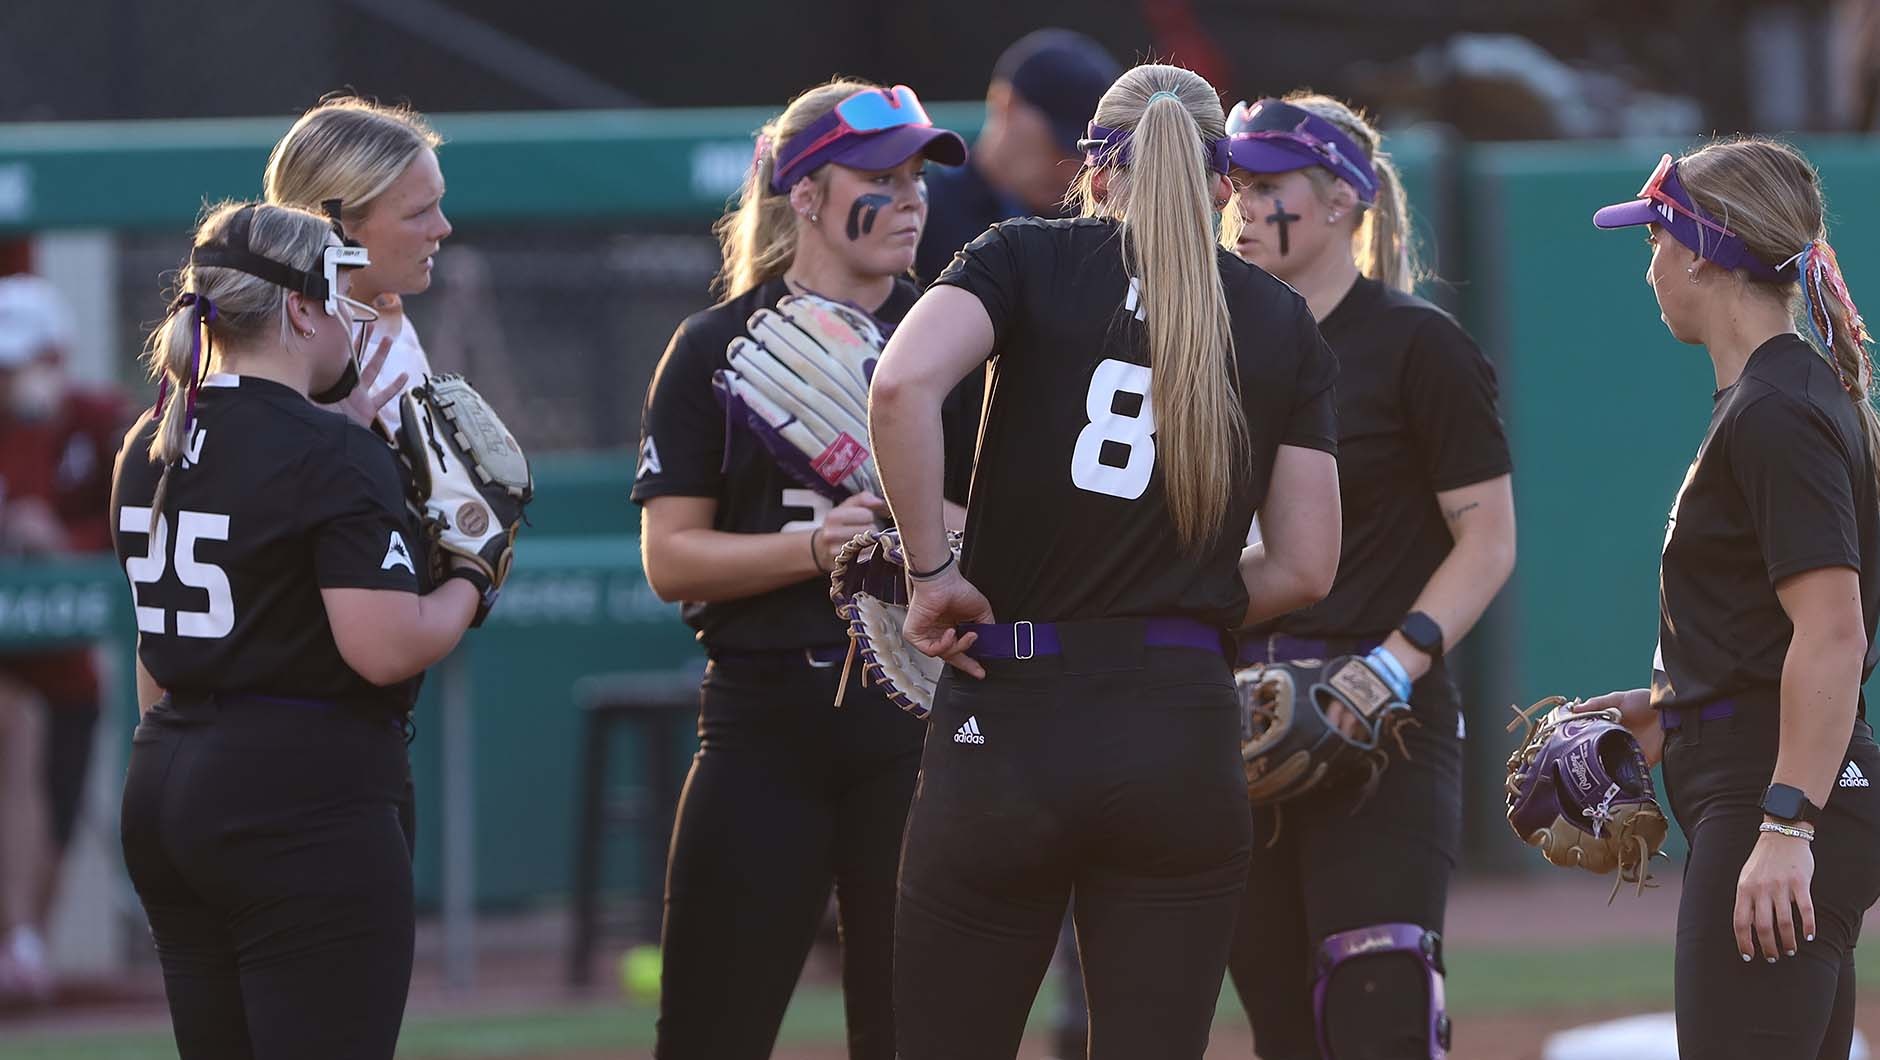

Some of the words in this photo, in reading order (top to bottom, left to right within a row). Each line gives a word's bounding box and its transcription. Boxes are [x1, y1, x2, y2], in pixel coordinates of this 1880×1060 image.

[1071, 358, 1157, 500] 8
[119, 506, 235, 639] 25
[953, 731, 985, 744] adidas
[1839, 777, 1869, 787] adidas
